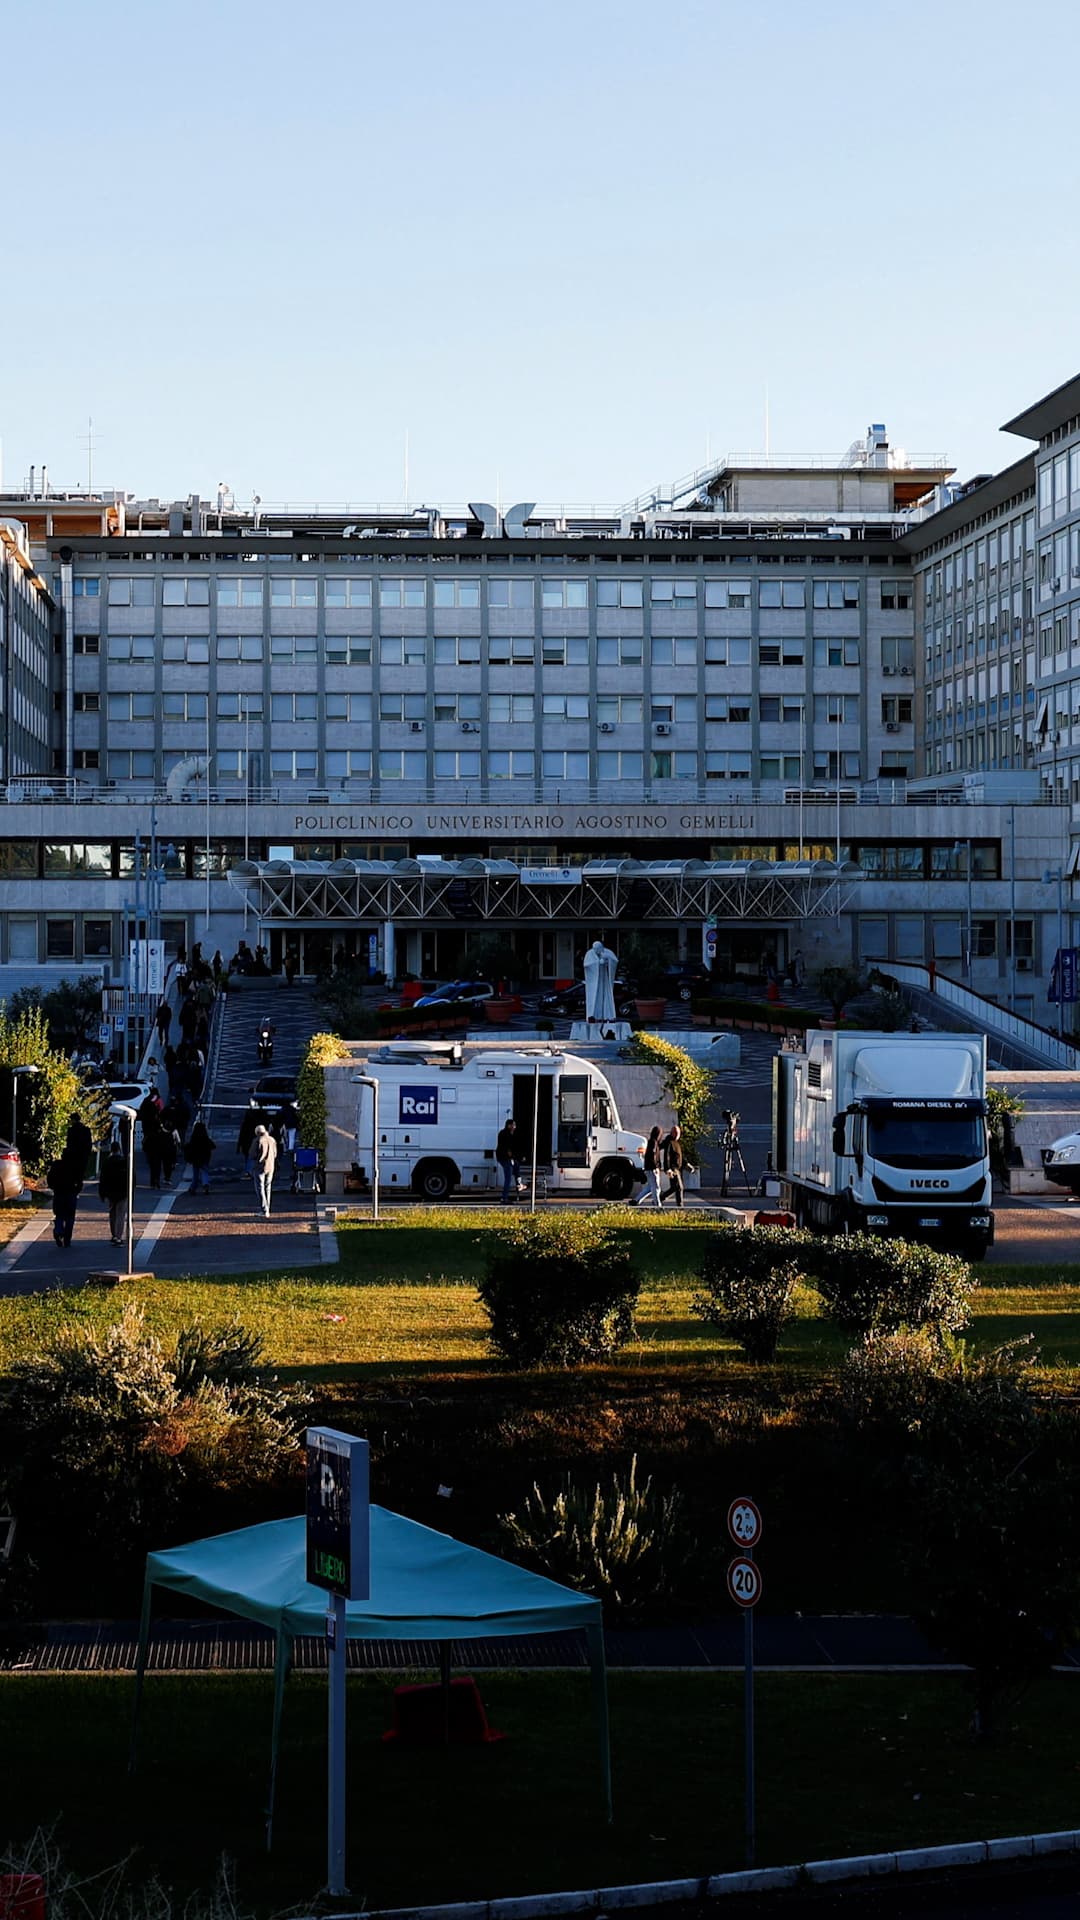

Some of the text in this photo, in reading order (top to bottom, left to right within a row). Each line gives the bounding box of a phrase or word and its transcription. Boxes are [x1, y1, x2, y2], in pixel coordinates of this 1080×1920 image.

[295, 815, 754, 830] POLICLINICO UNIVERSITARIO AGOSTINO GEMELLI
[1062, 968, 1073, 999] Gemelli
[402, 1096, 435, 1114] Rai
[910, 1179, 949, 1188] IVECO
[314, 1549, 346, 1585] LIBERO
[735, 1569, 753, 1593] 20
